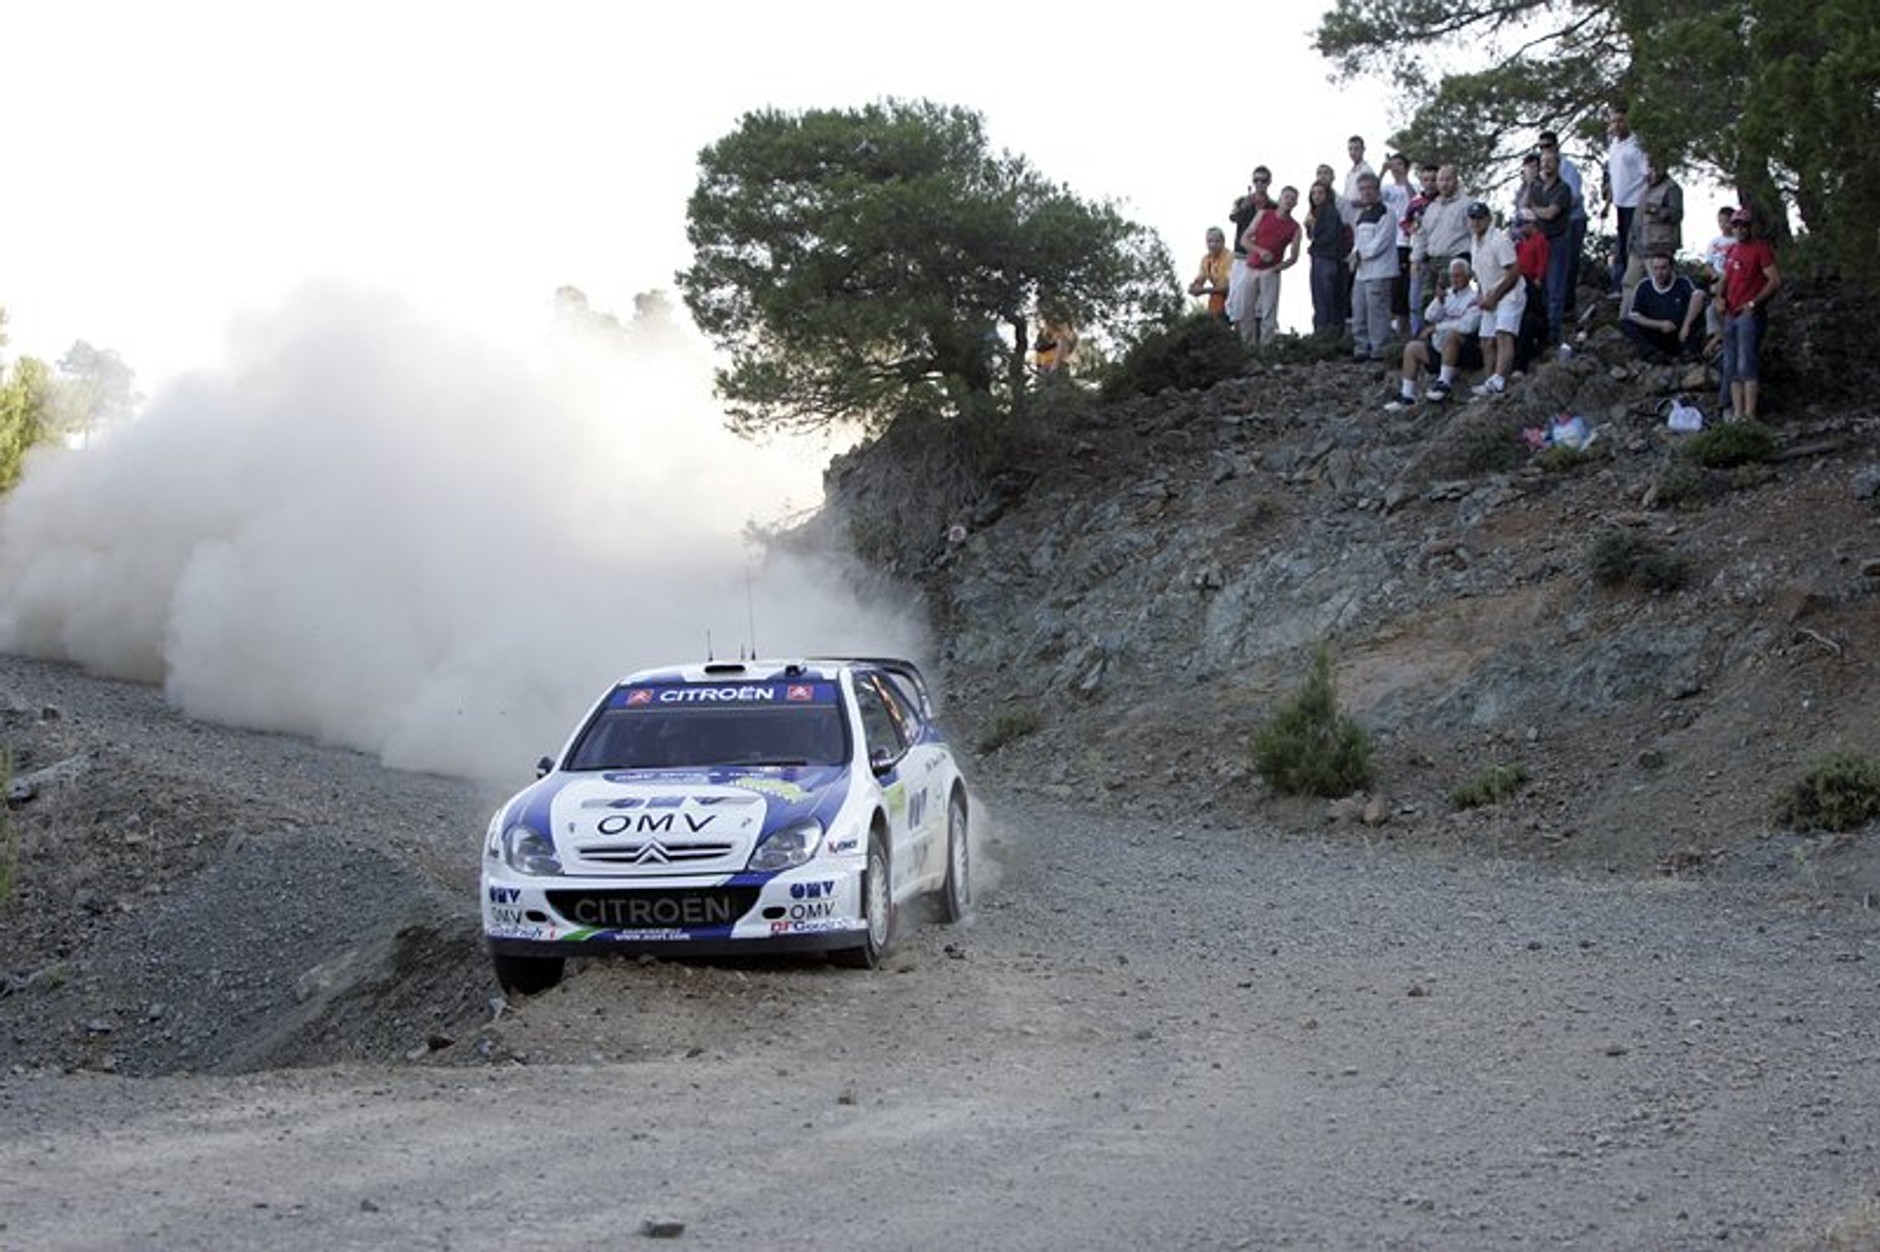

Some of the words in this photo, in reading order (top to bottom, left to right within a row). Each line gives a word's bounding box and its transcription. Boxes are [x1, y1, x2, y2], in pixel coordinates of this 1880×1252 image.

[660, 685, 774, 701] CITROËN
[597, 813, 716, 835] OMV
[789, 901, 835, 920] OMV
